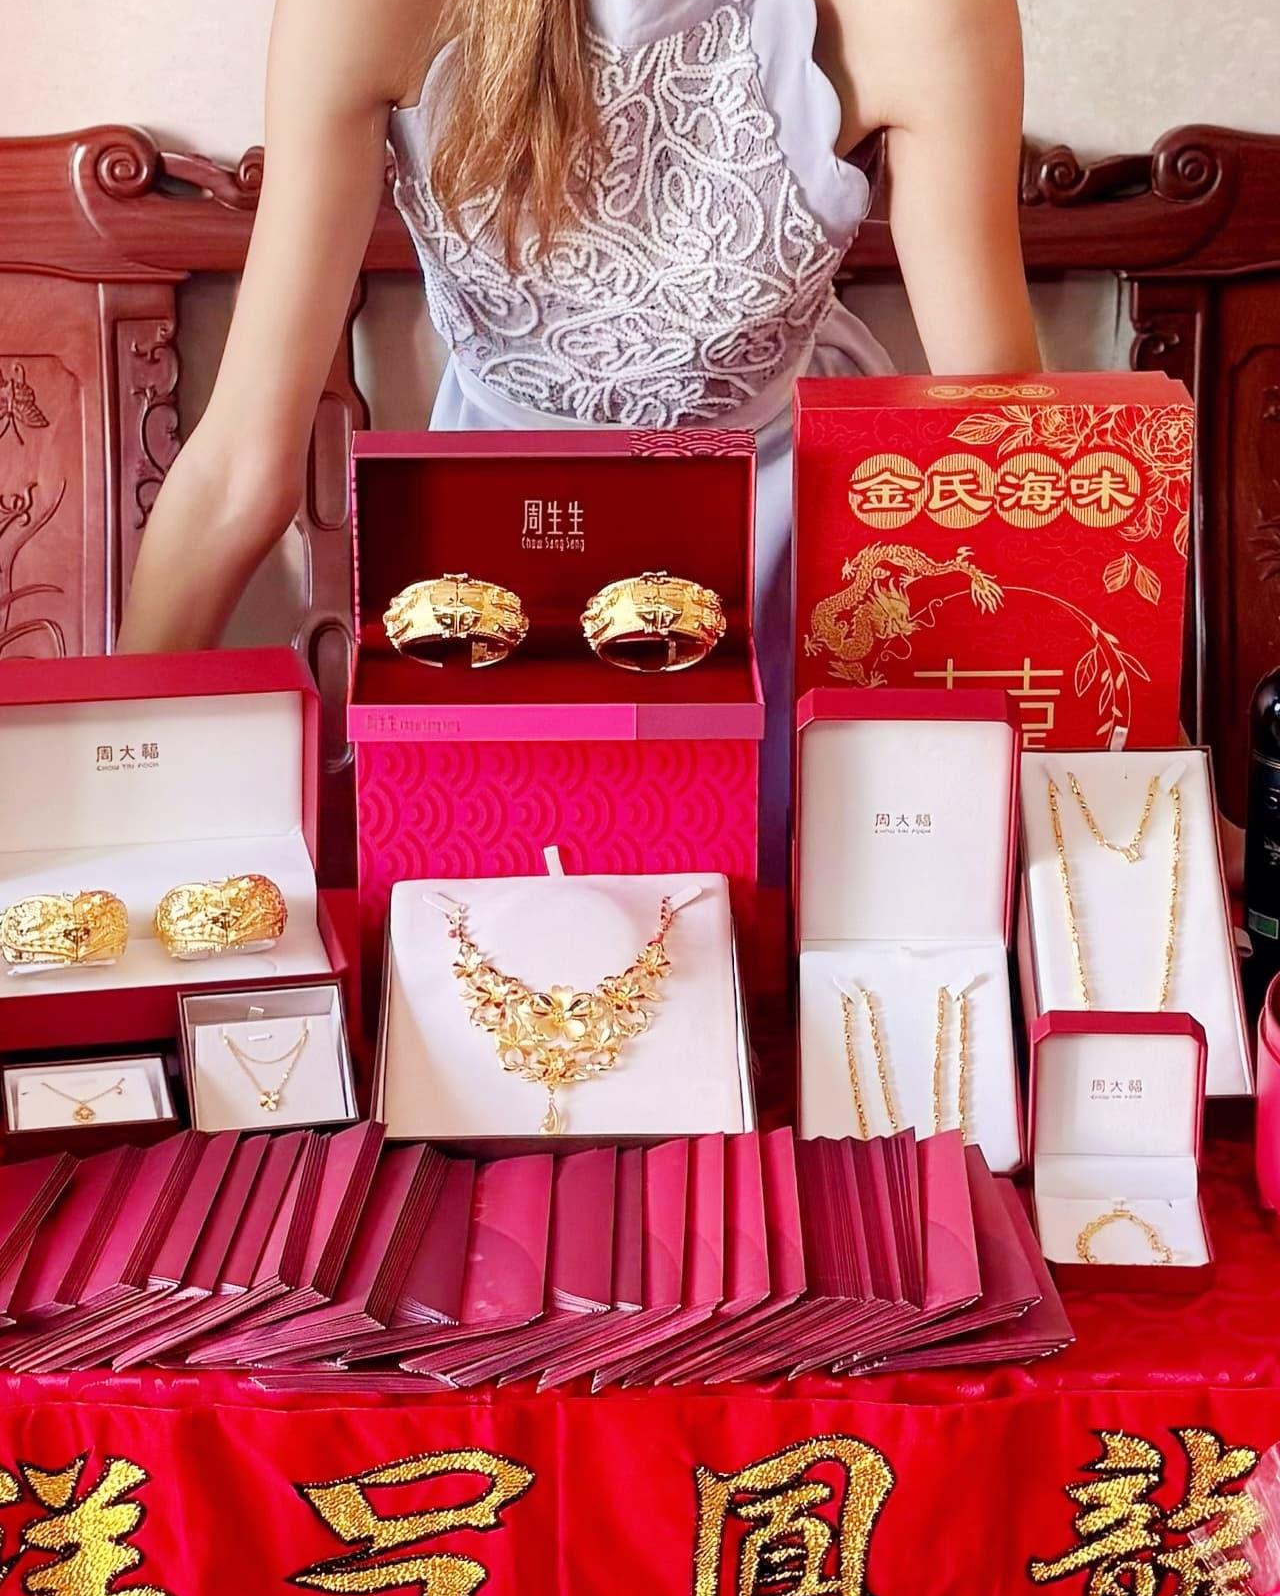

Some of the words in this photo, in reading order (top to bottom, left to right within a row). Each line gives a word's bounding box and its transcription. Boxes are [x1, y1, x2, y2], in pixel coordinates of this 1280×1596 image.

[851, 471, 1136, 512] 金氏海味
[522, 500, 585, 535] 周生生
[96, 743, 159, 763] 周大福
